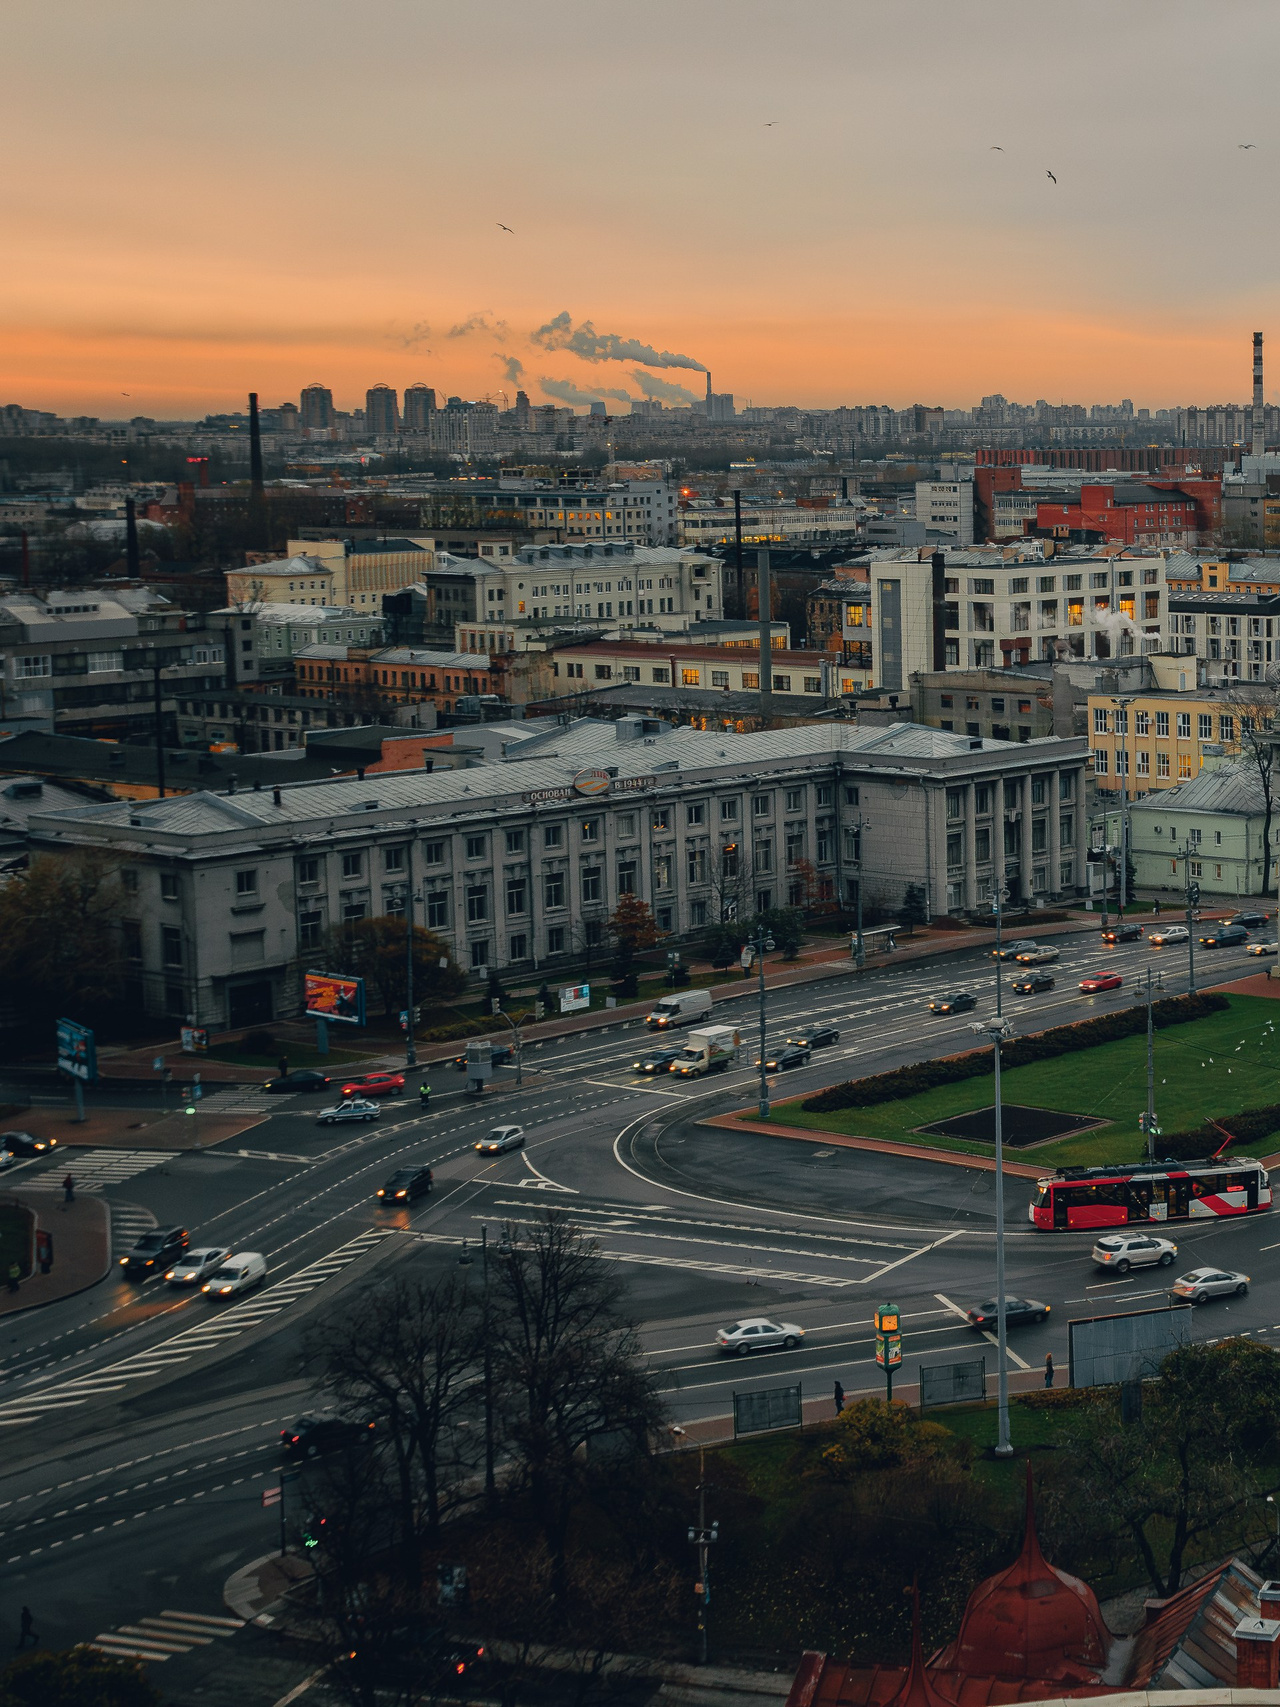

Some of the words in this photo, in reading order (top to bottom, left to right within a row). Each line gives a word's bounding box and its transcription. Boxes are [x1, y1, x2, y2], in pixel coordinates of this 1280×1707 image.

[530, 788, 571, 801] ОСНОВАН
[614, 781, 621, 789] В
[623, 778, 643, 788] 1944
